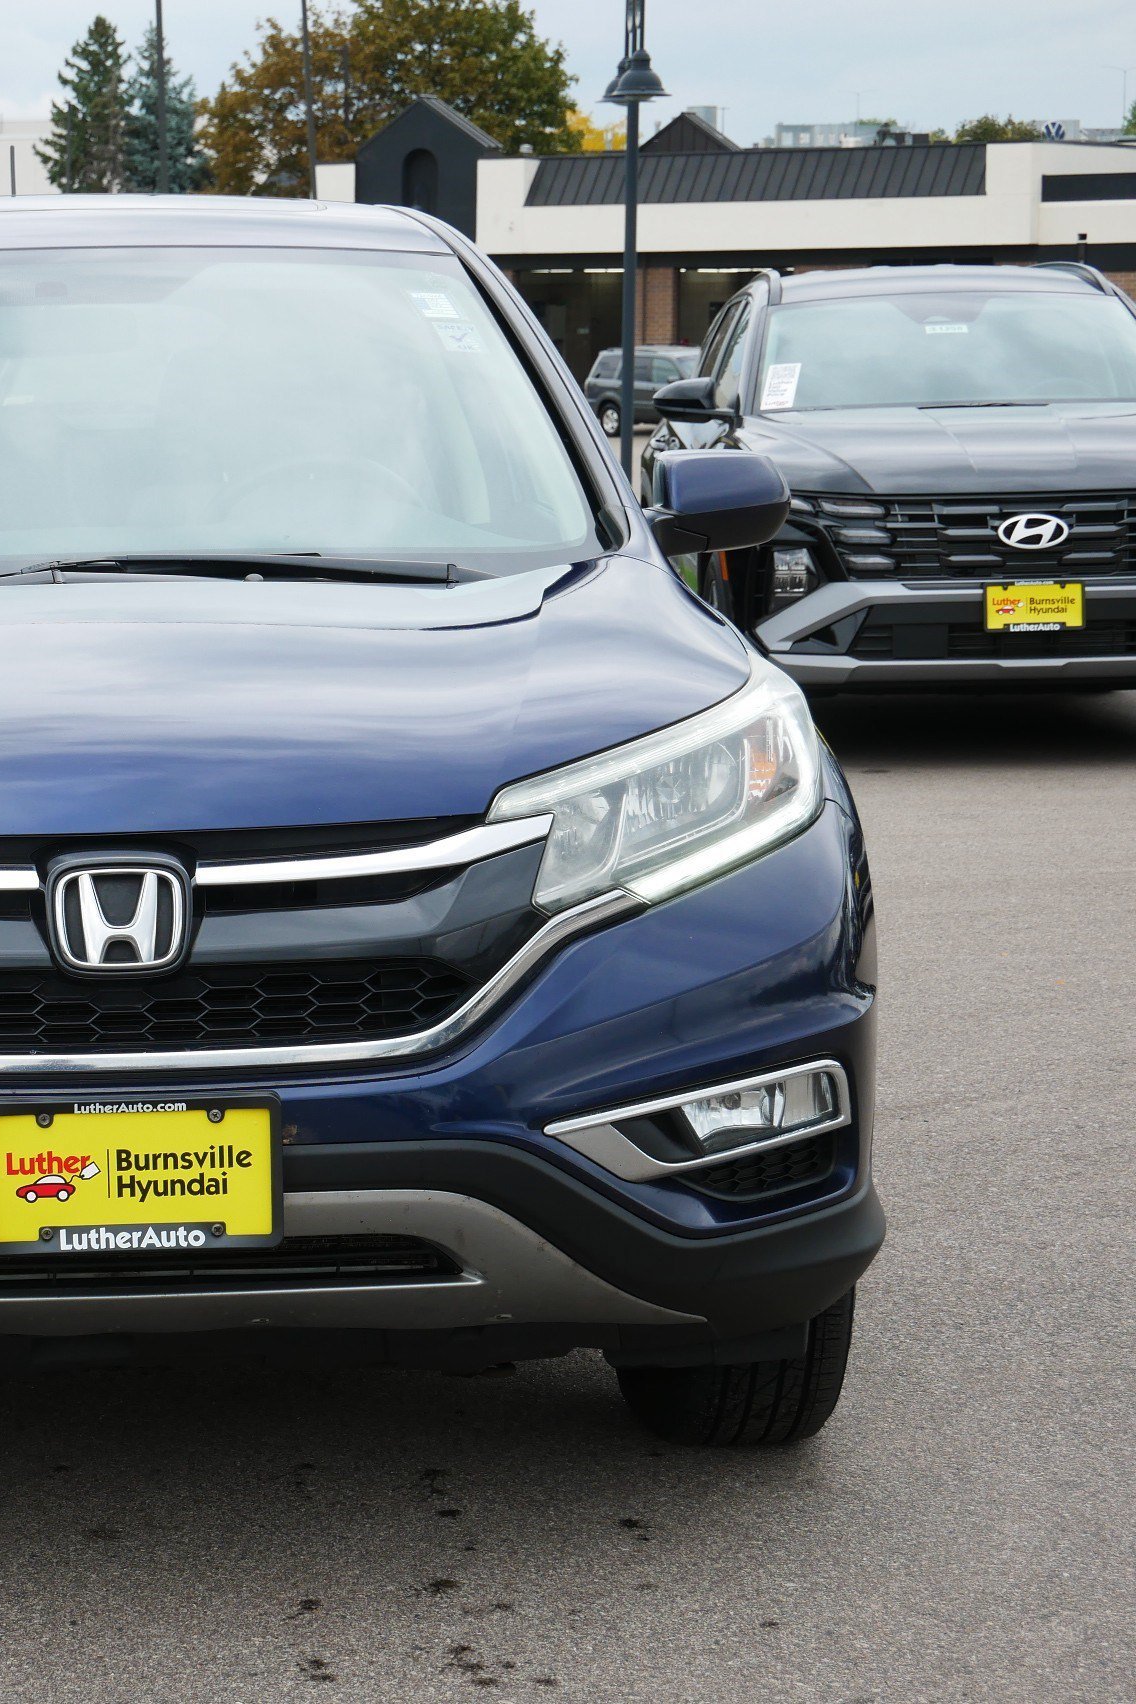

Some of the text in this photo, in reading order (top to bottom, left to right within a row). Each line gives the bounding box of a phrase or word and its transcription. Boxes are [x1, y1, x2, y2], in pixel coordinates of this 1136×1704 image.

[992, 598, 1021, 606] Luther
[1029, 597, 1076, 605] Burnsville
[1029, 605, 1068, 615] Hyundai
[1009, 623, 1061, 632] LutherAuto
[73, 1101, 187, 1114] LutherAuto.com
[6, 1150, 91, 1175] Luther
[115, 1145, 253, 1172] Burnsville
[116, 1172, 228, 1202] Hyundai
[59, 1226, 206, 1250] LutherAuto
